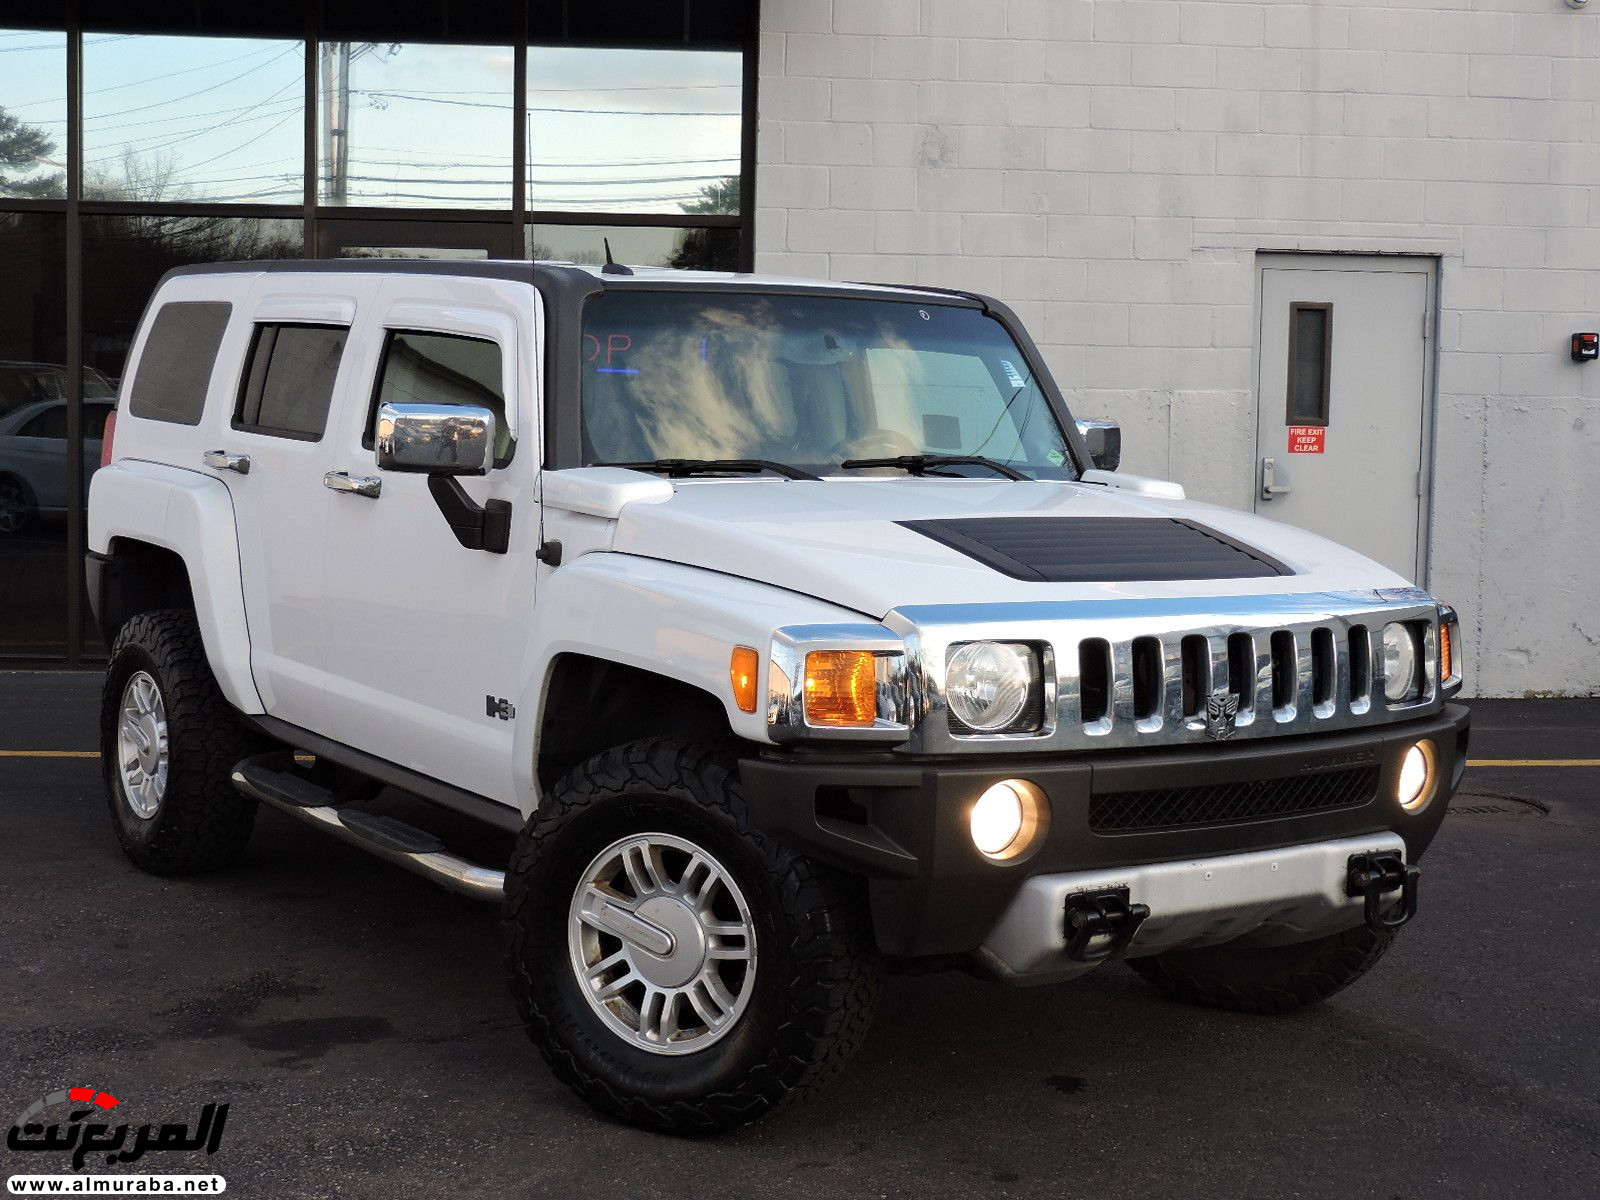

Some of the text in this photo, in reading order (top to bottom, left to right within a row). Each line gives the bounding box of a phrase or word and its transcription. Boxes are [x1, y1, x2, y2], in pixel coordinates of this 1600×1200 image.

[1290, 428, 1307, 436] FIRE
[1297, 436, 1317, 444] KEEP
[486, 695, 516, 721] H3
